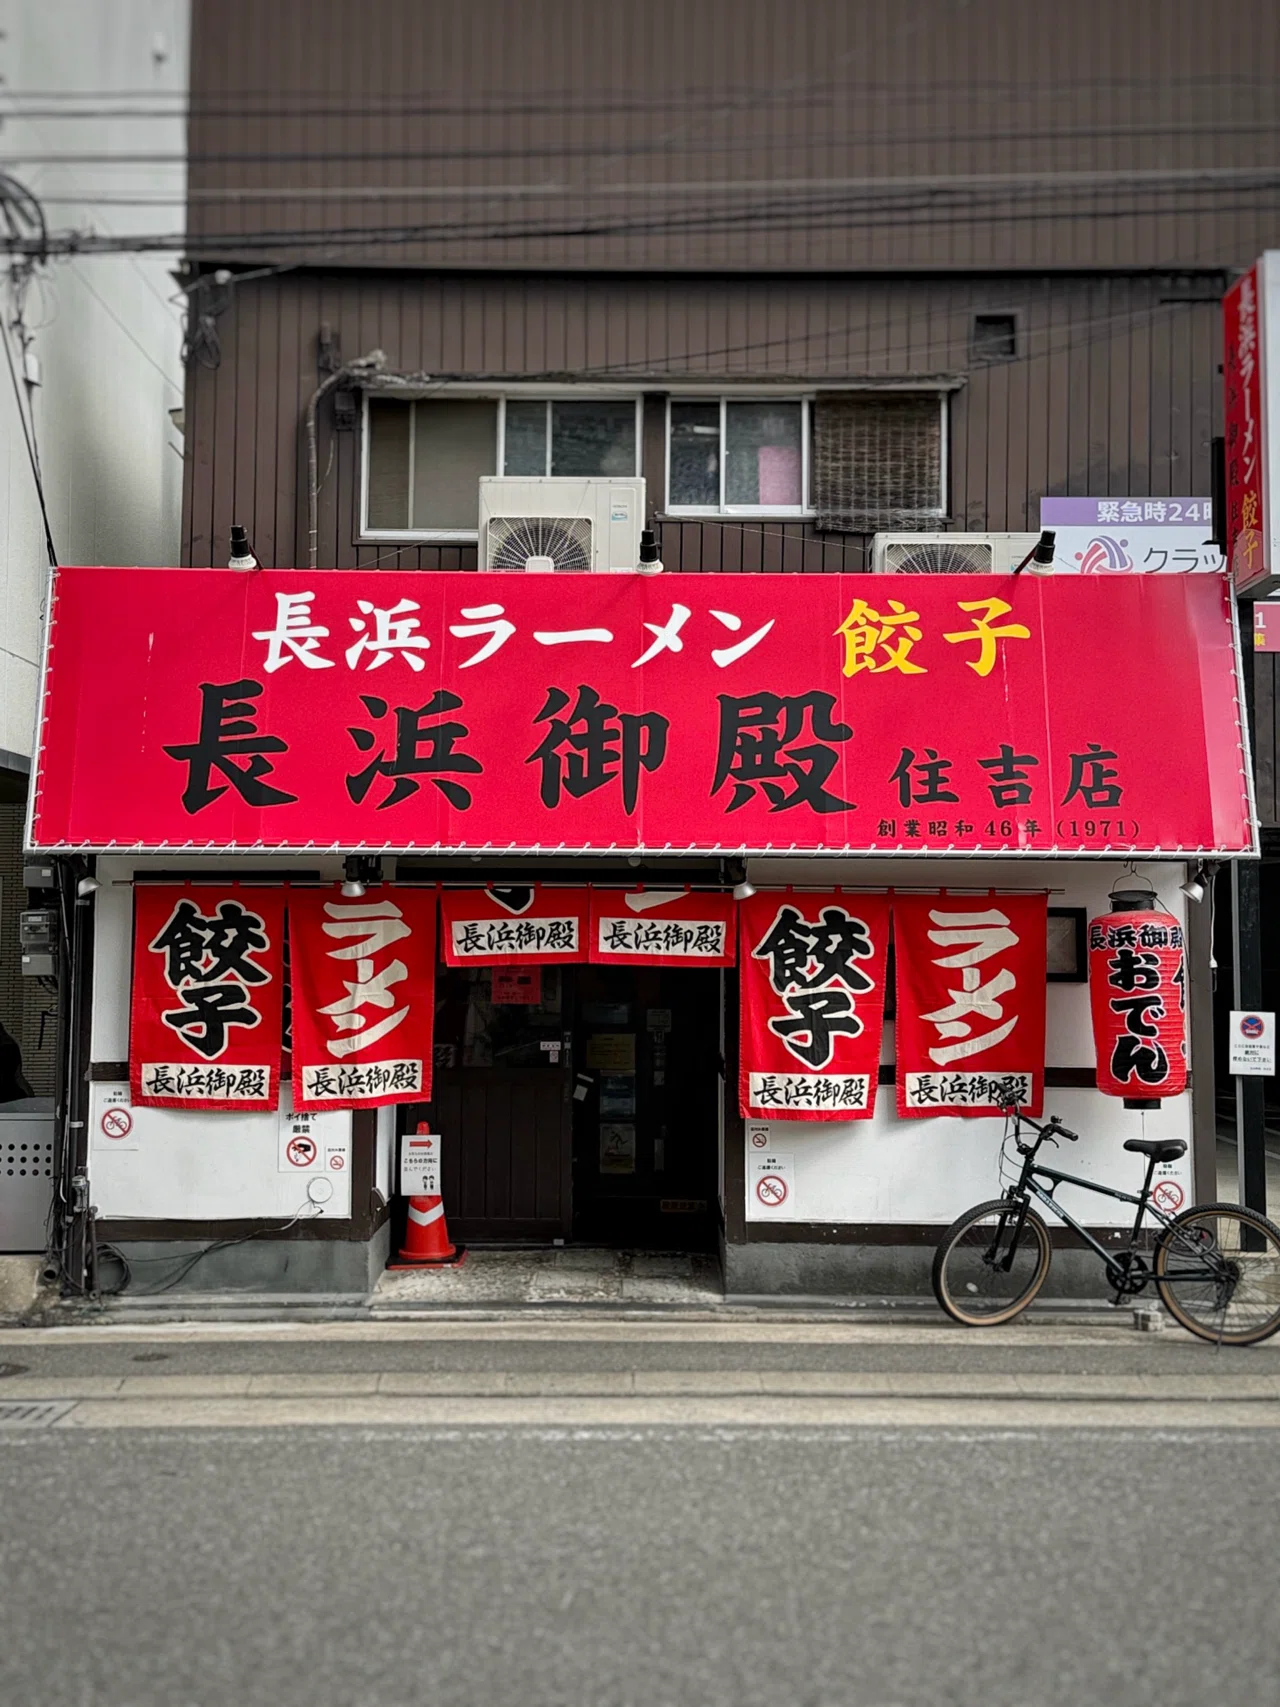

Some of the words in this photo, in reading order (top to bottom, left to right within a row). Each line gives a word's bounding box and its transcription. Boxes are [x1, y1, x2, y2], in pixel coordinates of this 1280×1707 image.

[252, 592, 775, 674] 長浜ラーメン
[836, 598, 1031, 677] 餃子
[163, 680, 857, 815] 長浜御殿
[890, 743, 1123, 808] 住吉店
[1056, 819, 1140, 838] (1971)
[456, 920, 575, 953] 長浜御殿
[603, 921, 723, 954] 長浜御殿
[148, 898, 273, 1061] 餃子
[316, 900, 412, 1059] ラーメン
[751, 904, 876, 1072] 餃子
[918, 908, 1020, 1067] ラーメン
[1107, 948, 1170, 1085] おでん
[145, 1065, 266, 1098] 長浜御殿
[307, 1062, 419, 1097] 長浜御殿
[753, 1076, 865, 1107] 長浜御殿
